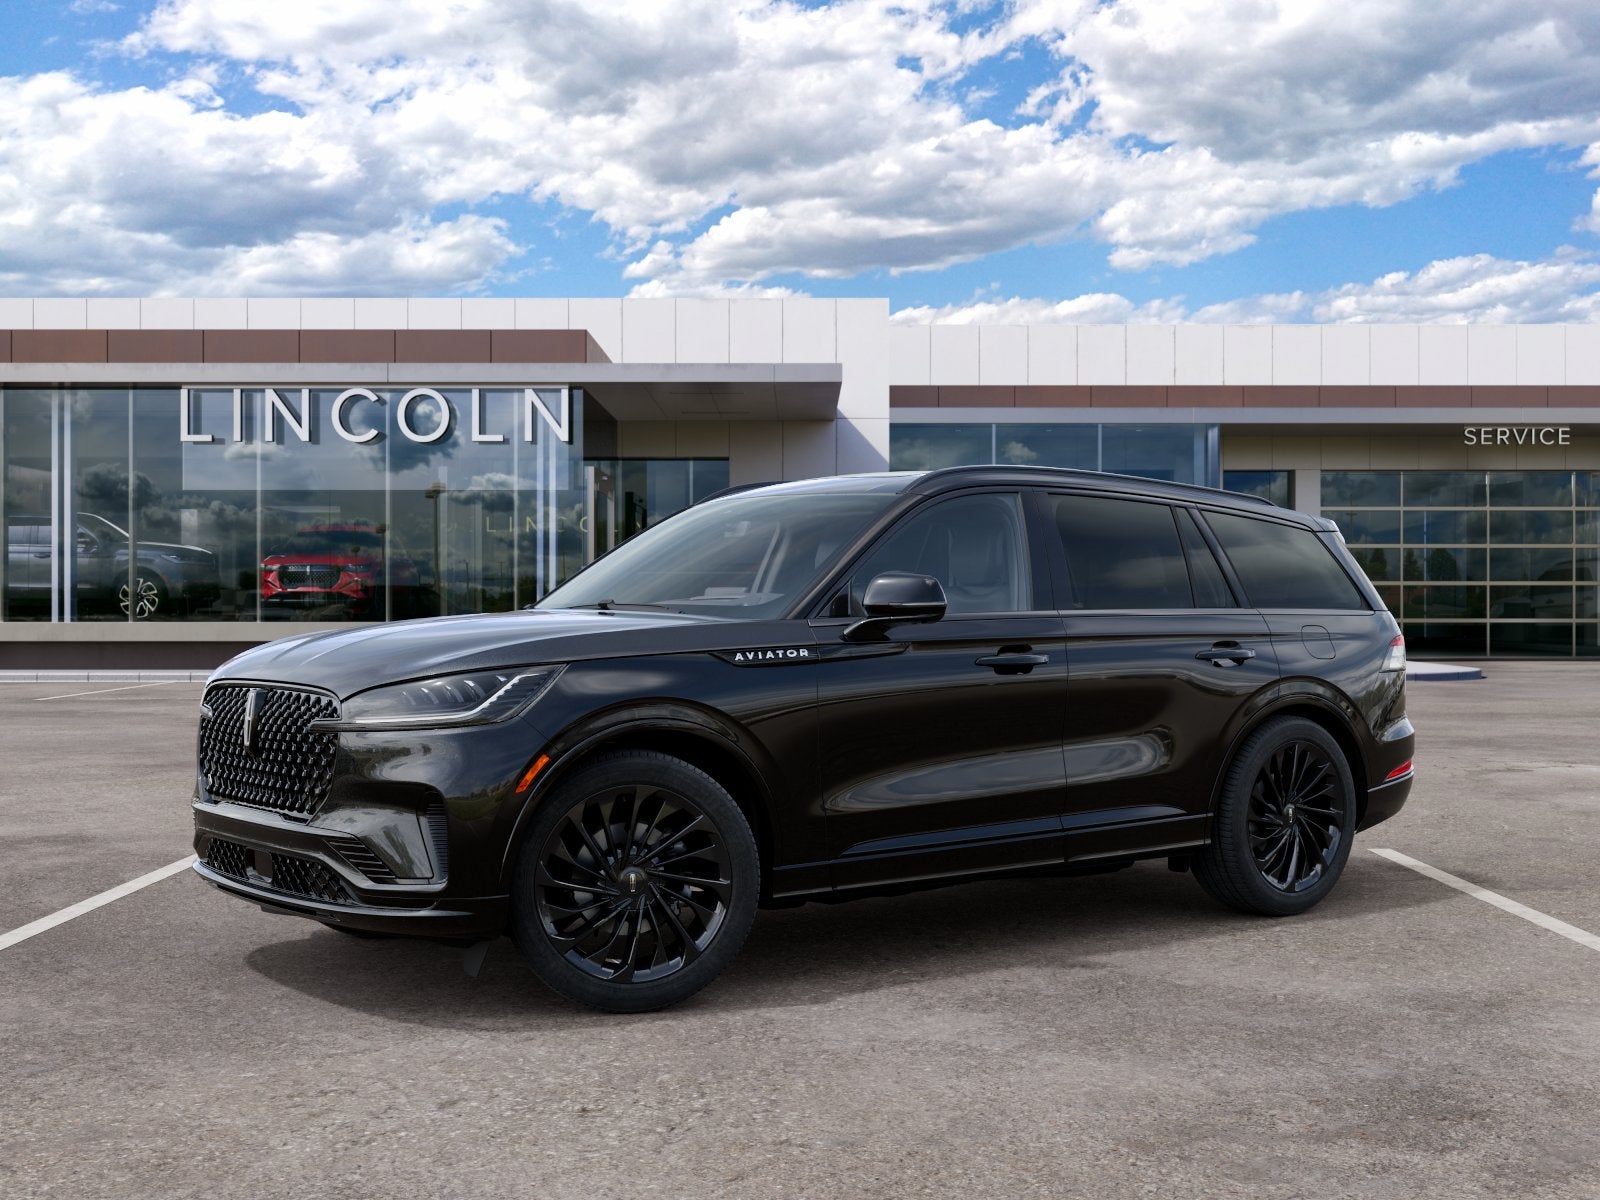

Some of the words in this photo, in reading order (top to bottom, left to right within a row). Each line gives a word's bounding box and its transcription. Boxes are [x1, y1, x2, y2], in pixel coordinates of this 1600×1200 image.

[180, 387, 570, 443] LINCOLN
[1463, 427, 1571, 445] SERVICE
[734, 648, 809, 661] AVIATOR
